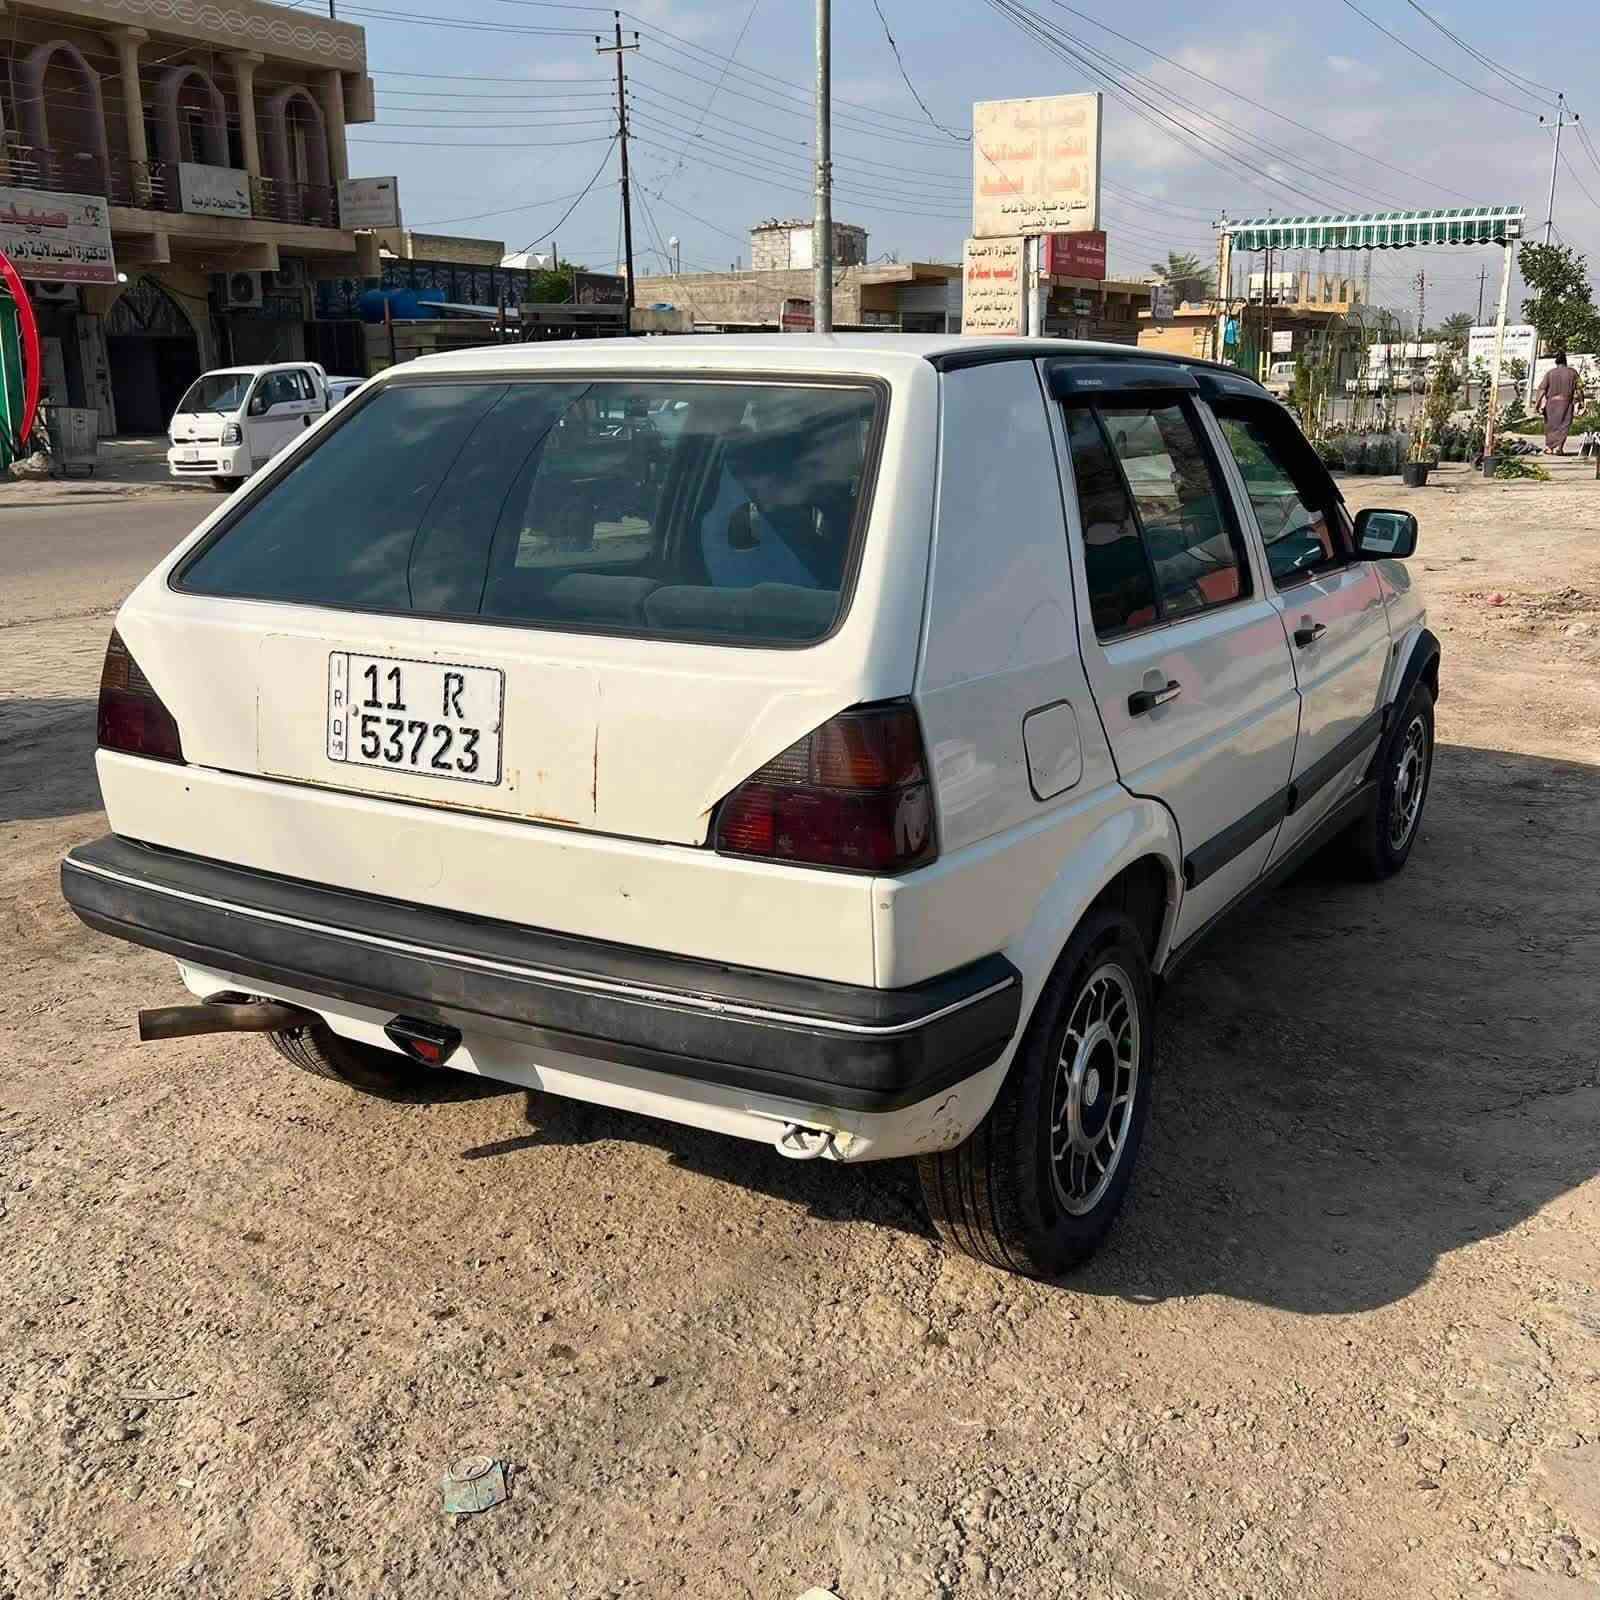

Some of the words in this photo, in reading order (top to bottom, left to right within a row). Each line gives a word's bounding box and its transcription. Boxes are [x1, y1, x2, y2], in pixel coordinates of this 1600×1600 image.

[363, 664, 407, 712] 11
[443, 671, 464, 719] R
[361, 714, 481, 774] 53723
